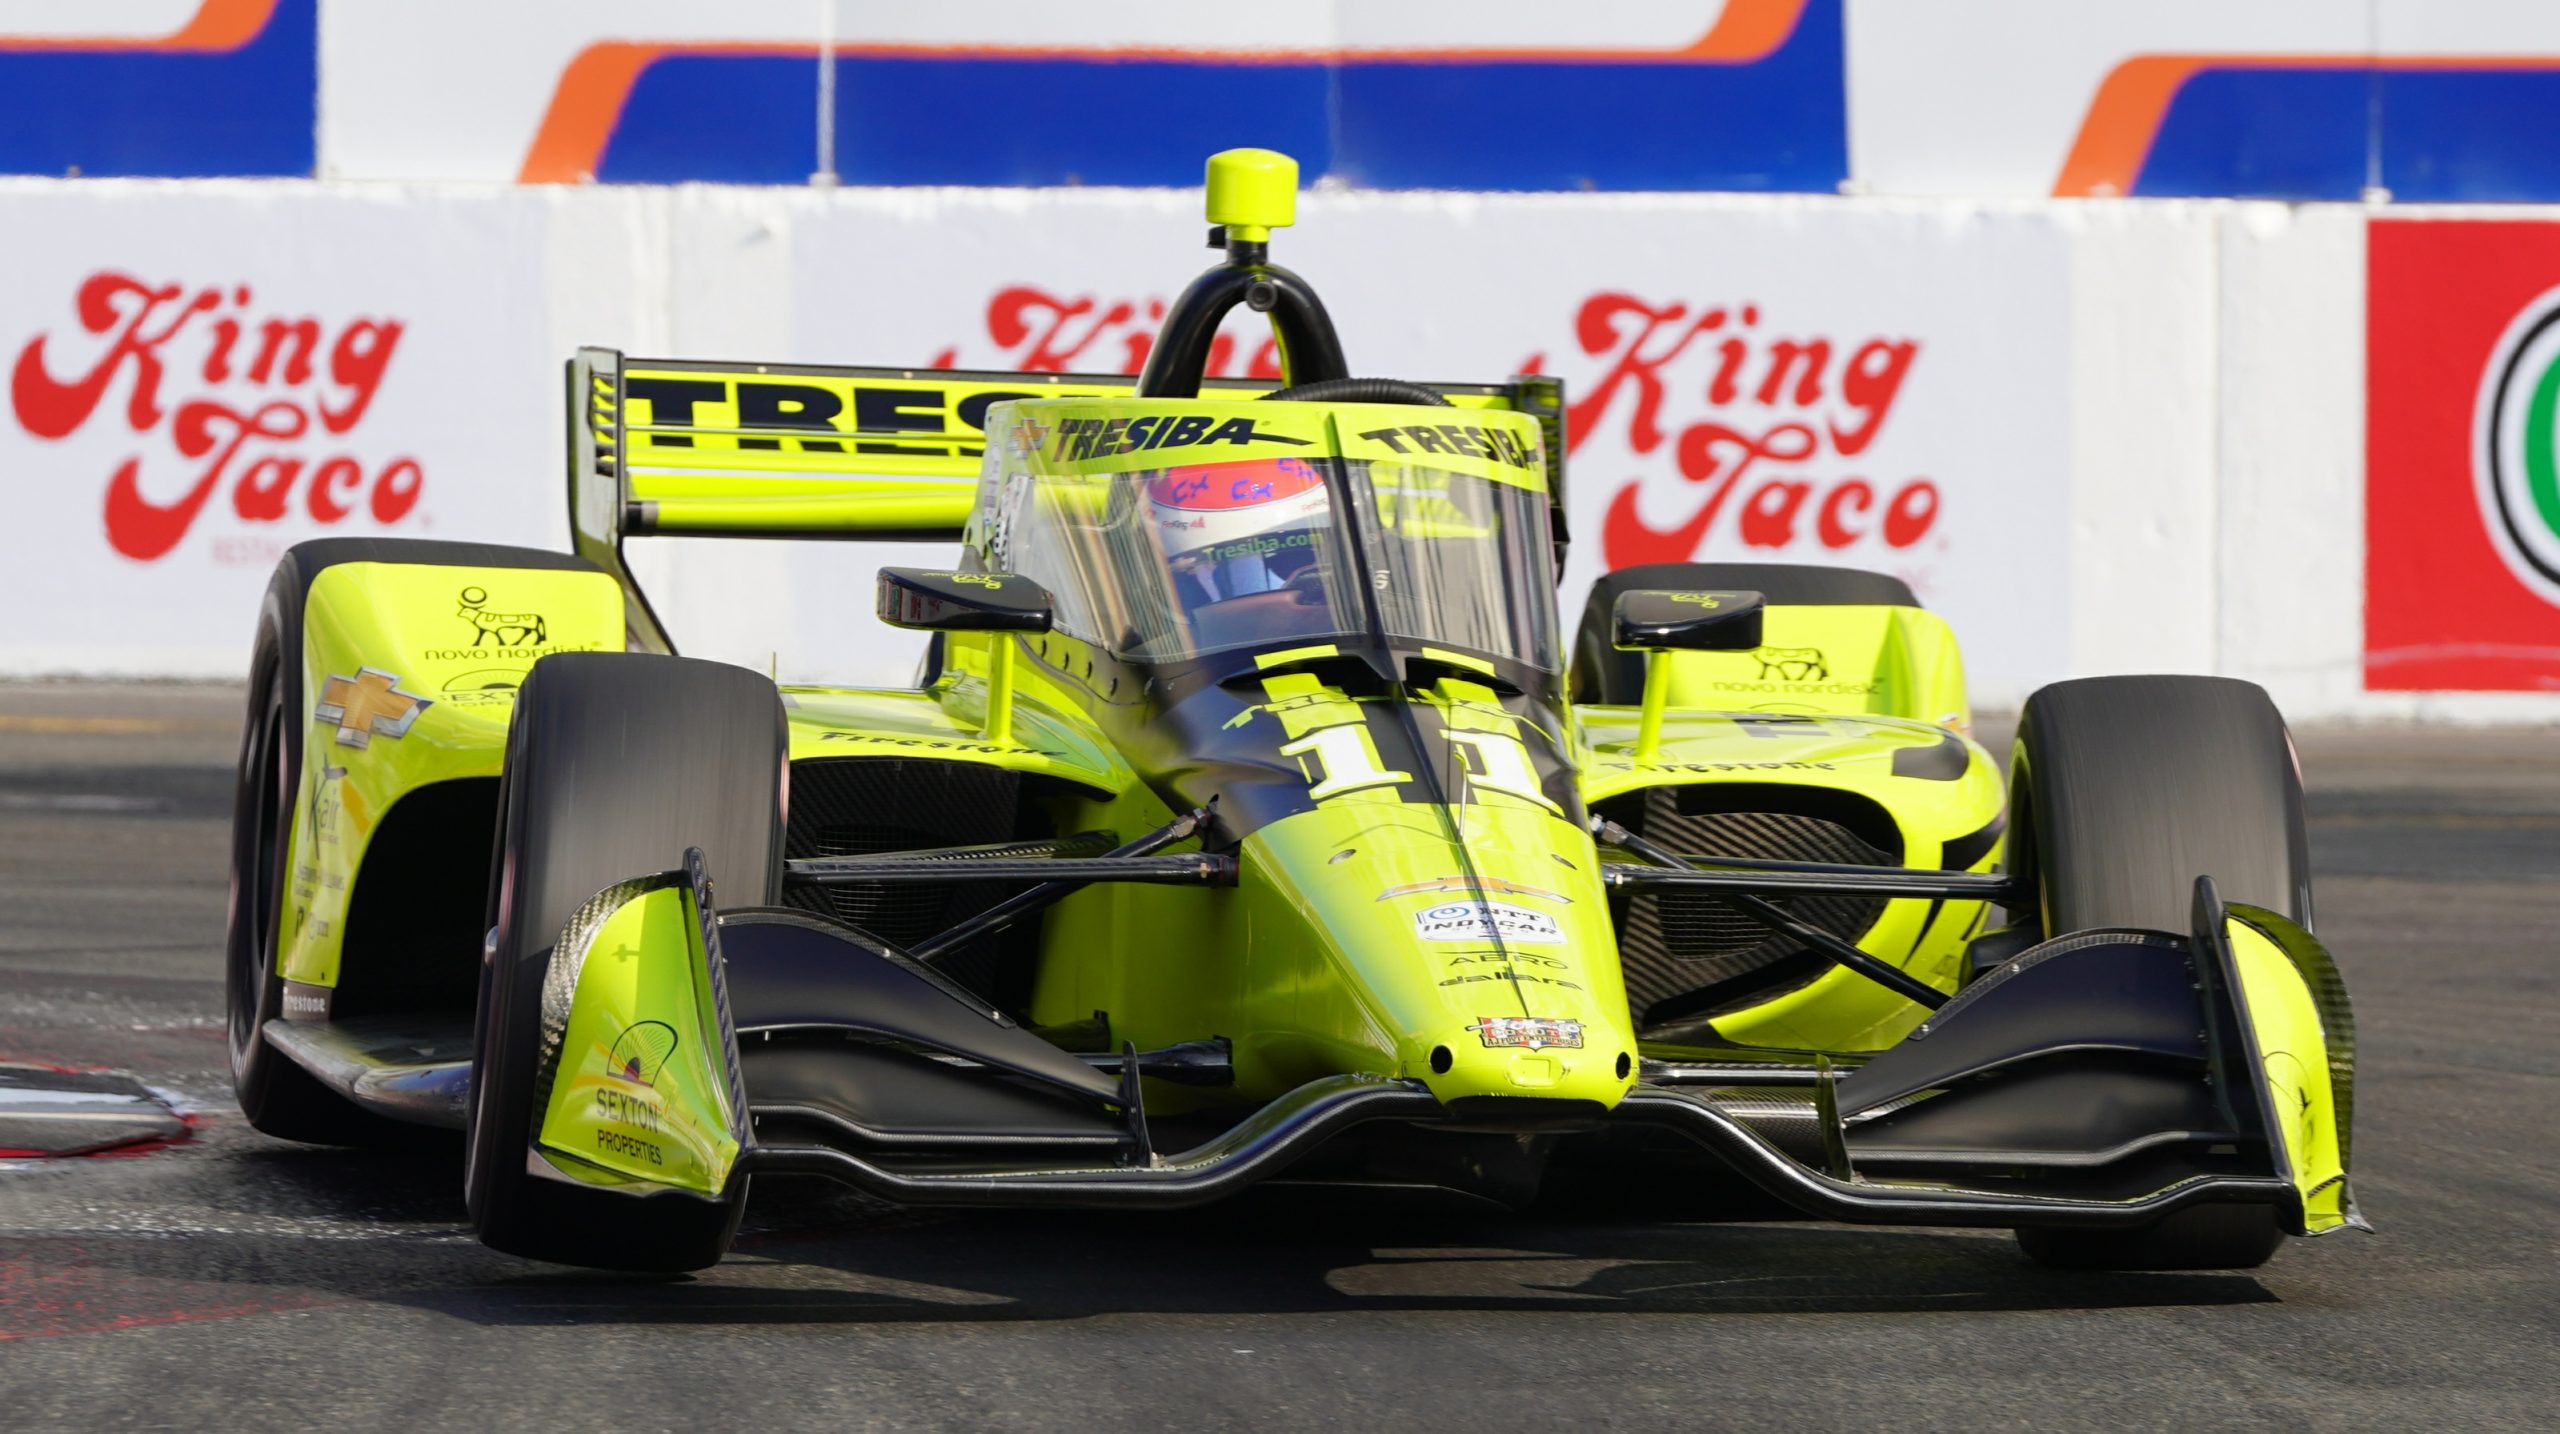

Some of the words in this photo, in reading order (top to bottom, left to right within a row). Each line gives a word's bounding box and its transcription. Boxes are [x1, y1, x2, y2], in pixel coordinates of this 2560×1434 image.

[11, 270, 406, 439] King
[1519, 291, 1920, 455] King
[1053, 416, 1258, 462] TRESIBA
[104, 401, 424, 562] Taco
[1603, 422, 1940, 566] Taco
[1203, 530, 1324, 563] Tresiba.com
[425, 648, 488, 660] novo
[1713, 680, 1776, 693] novo
[1784, 679, 1879, 695] nordisk
[819, 731, 1068, 756] Firestone
[1600, 761, 1836, 773] Firestone
[1424, 919, 1558, 935] INDYCAR
[1478, 907, 1540, 922] NTT
[1449, 953, 1568, 969] AERO
[1438, 971, 1582, 990] dallara
[596, 1087, 659, 1134] SEXTON
[597, 1129, 663, 1167] PROPERTIES
